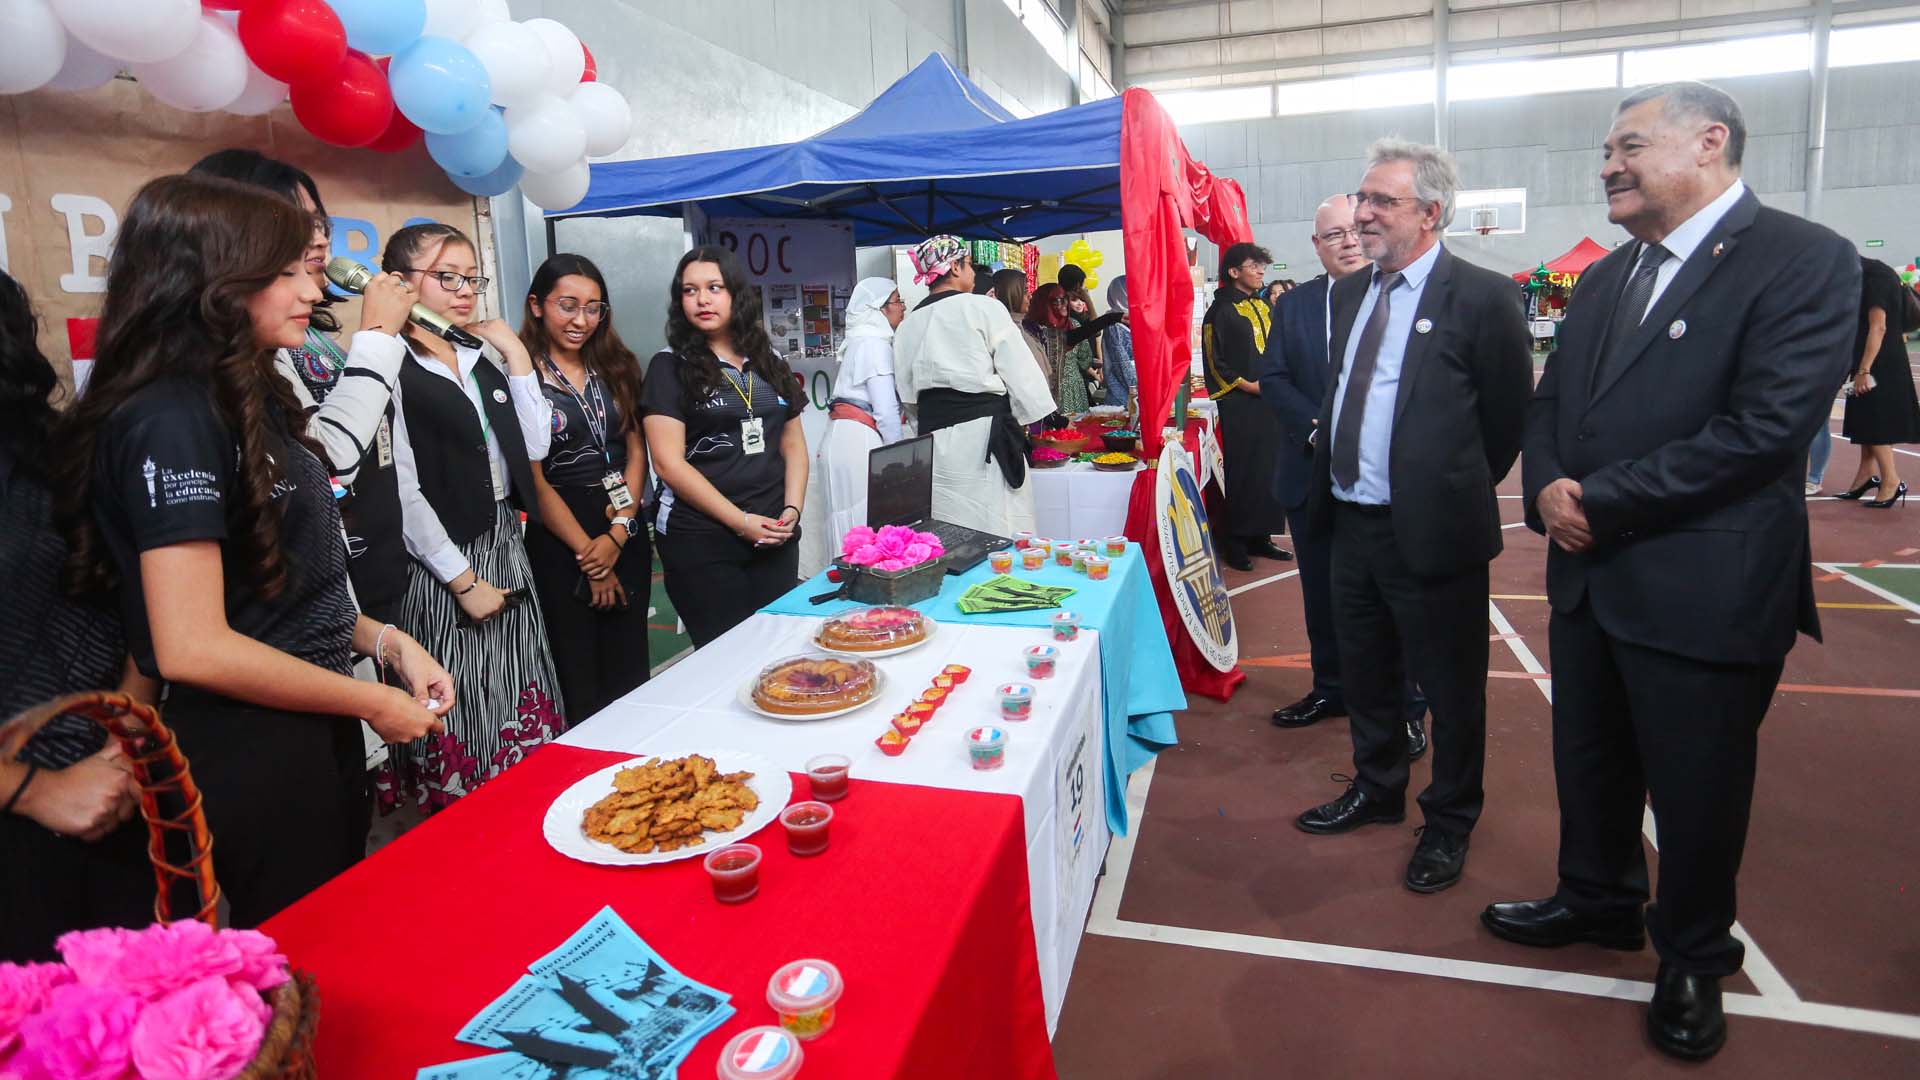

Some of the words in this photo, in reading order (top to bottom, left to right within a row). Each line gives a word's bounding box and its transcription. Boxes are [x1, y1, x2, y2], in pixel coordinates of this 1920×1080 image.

[164, 482, 177, 490] por
[165, 491, 174, 499] la
[1162, 512, 1177, 577] Superior
[1071, 763, 1083, 813] 19
[595, 920, 609, 934] au
